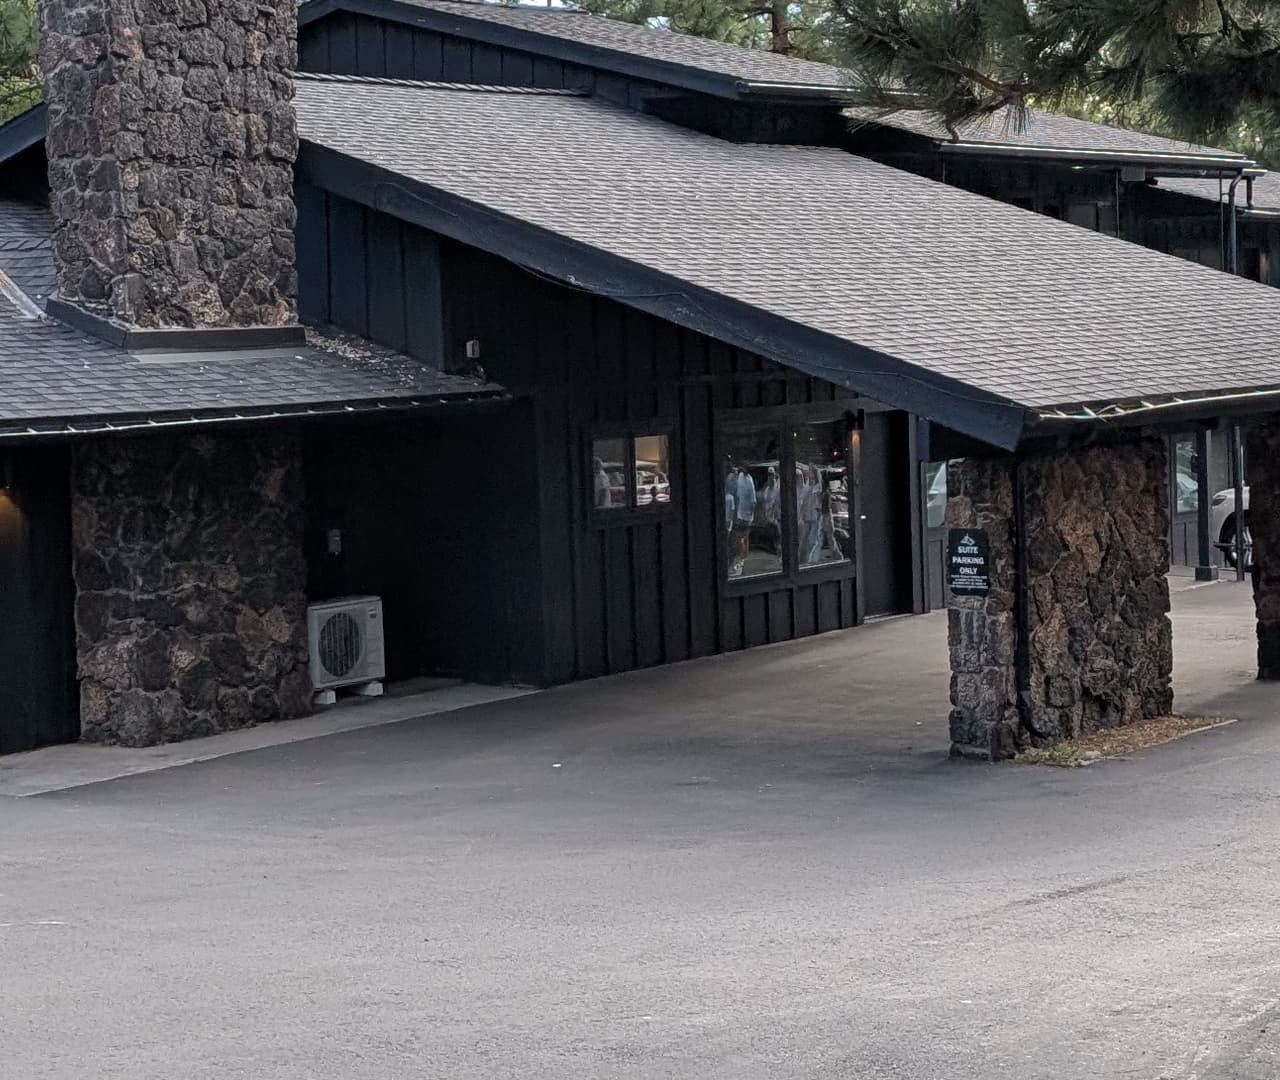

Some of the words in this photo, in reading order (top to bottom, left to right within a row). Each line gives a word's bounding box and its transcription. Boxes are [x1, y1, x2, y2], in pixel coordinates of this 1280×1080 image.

[958, 546, 979, 554] SUITE
[952, 556, 985, 565] PARKING
[959, 567, 978, 575] ONLY
